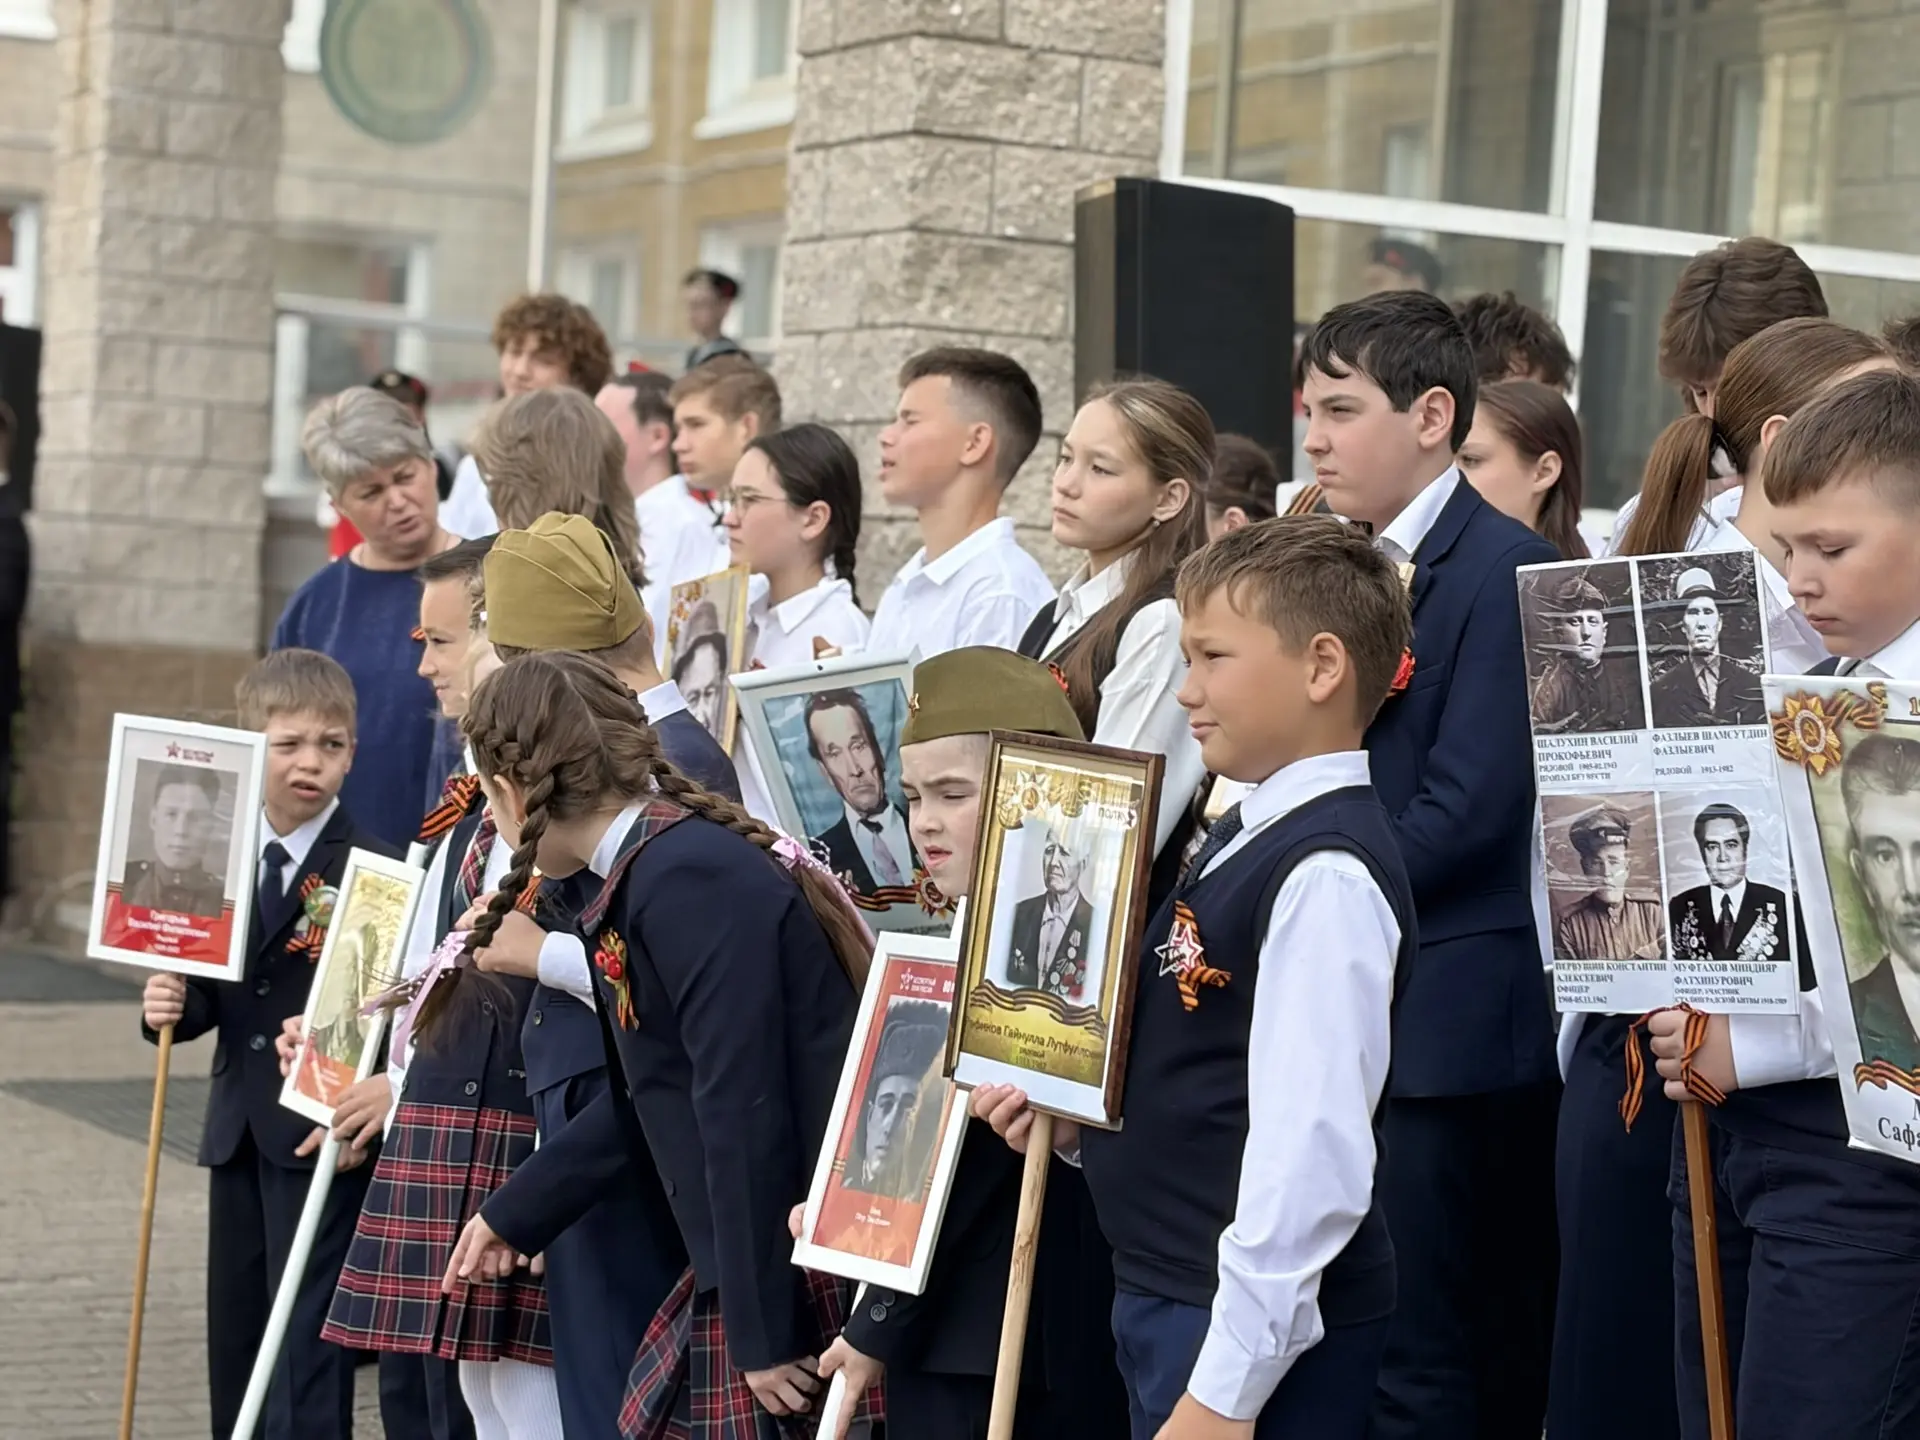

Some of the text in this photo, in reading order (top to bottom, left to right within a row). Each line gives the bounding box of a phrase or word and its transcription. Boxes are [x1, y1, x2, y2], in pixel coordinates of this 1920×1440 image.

[1536, 733, 1638, 748] ШАЛУХИН ВАСИЛИЙ
[1652, 729, 1768, 742] ФАЗЛЫЕВ ШАМСУТДИН
[1653, 744, 1715, 755] ФАЗЛЫЕВИЧ
[1538, 750, 1612, 761] ПРОКОФЬЕВИЧ
[1655, 765, 1692, 775] РЯДОВОЙ
[1606, 962, 1667, 971] КОНСТАНТИН
[1673, 962, 1728, 972] МУФТАХОВ
[1556, 974, 1614, 982] АЛЕКСЕЕВИЧ
